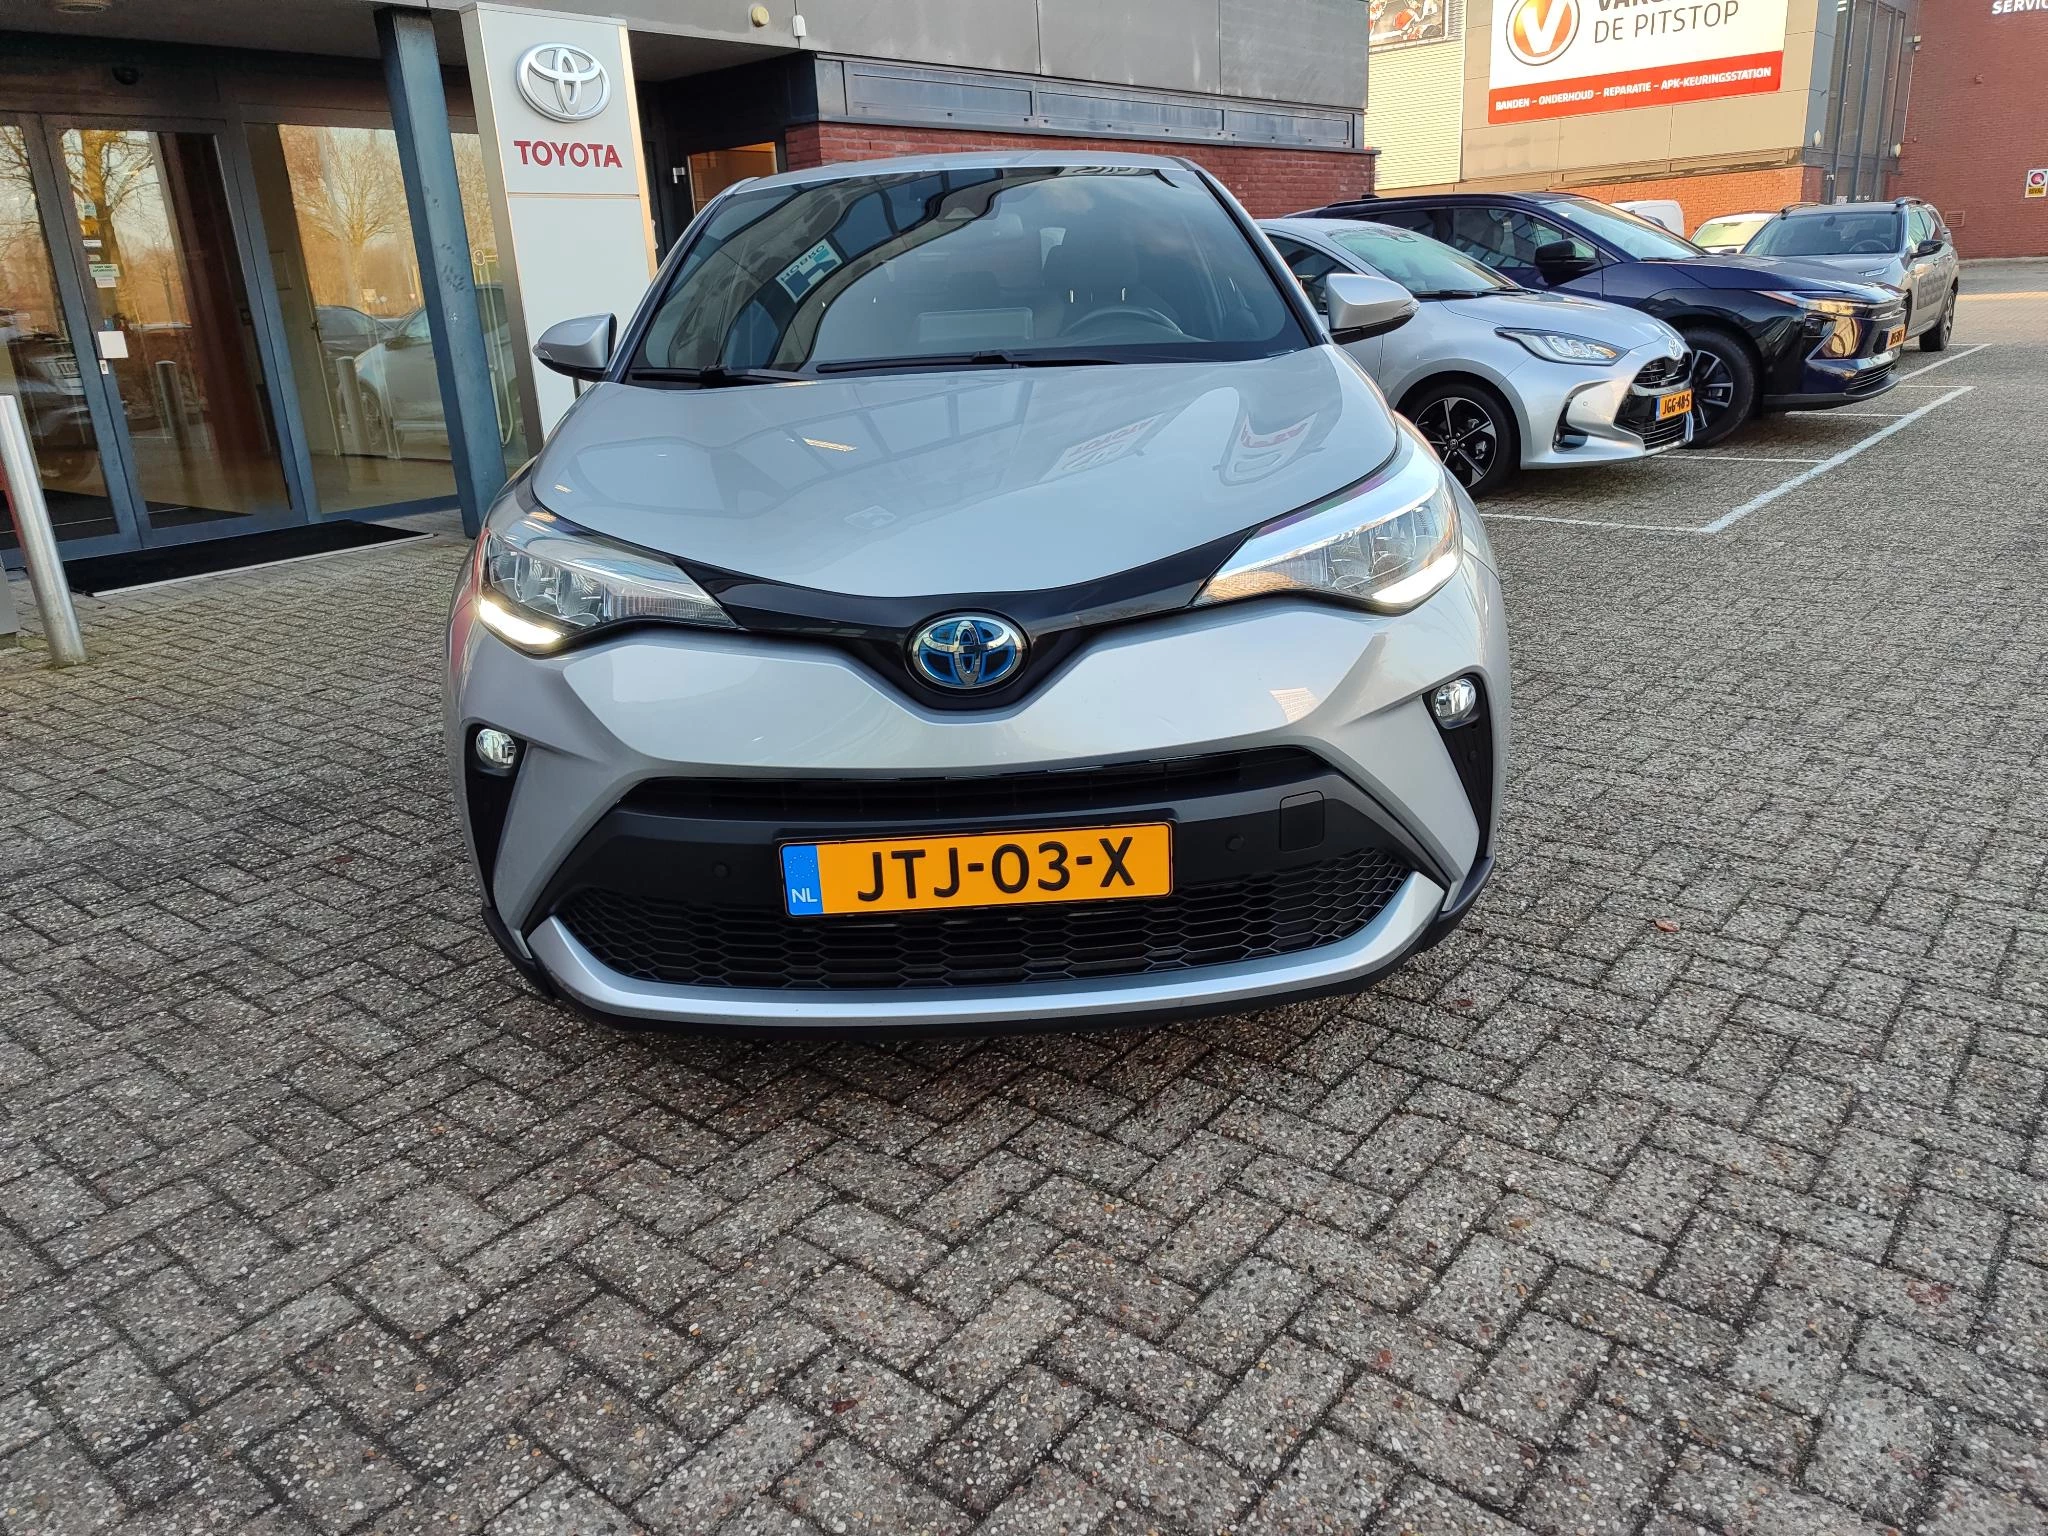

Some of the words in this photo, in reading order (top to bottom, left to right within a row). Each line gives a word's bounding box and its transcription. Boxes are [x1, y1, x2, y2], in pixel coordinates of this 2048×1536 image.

[1594, 18, 1625, 43] DE
[1634, 1, 1739, 37] PITSTOP
[1495, 97, 1530, 111] BANDEN
[1538, 89, 1594, 106] ONDERHOUD
[1603, 81, 1652, 98] REPARATIE
[1661, 66, 1772, 90] APK-KEURINGSSTATION
[513, 140, 623, 168] TOYOTA
[791, 887, 818, 904] NL
[857, 836, 1135, 902] JTJ-03-X
